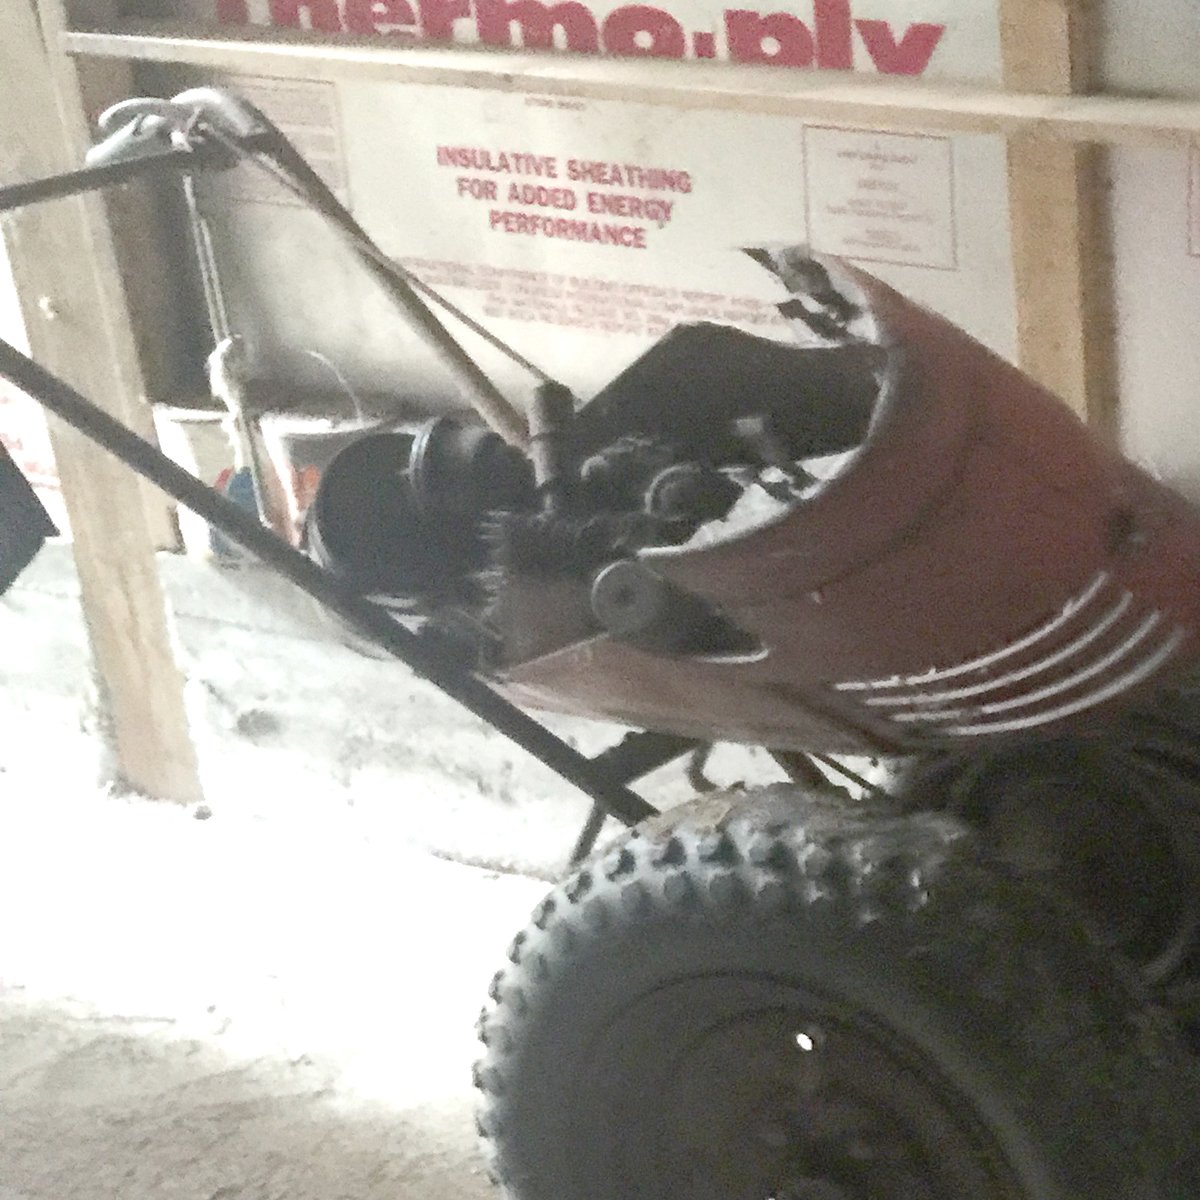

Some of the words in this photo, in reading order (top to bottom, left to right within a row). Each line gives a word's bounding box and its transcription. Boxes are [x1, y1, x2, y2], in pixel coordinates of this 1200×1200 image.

[437, 146, 558, 179] INSULATIVE
[567, 159, 693, 194] SHEATHING
[457, 177, 498, 201] FOR
[508, 182, 577, 211] ADDED
[587, 192, 674, 223] ENERGY
[489, 209, 648, 249] PERFORMANCE
